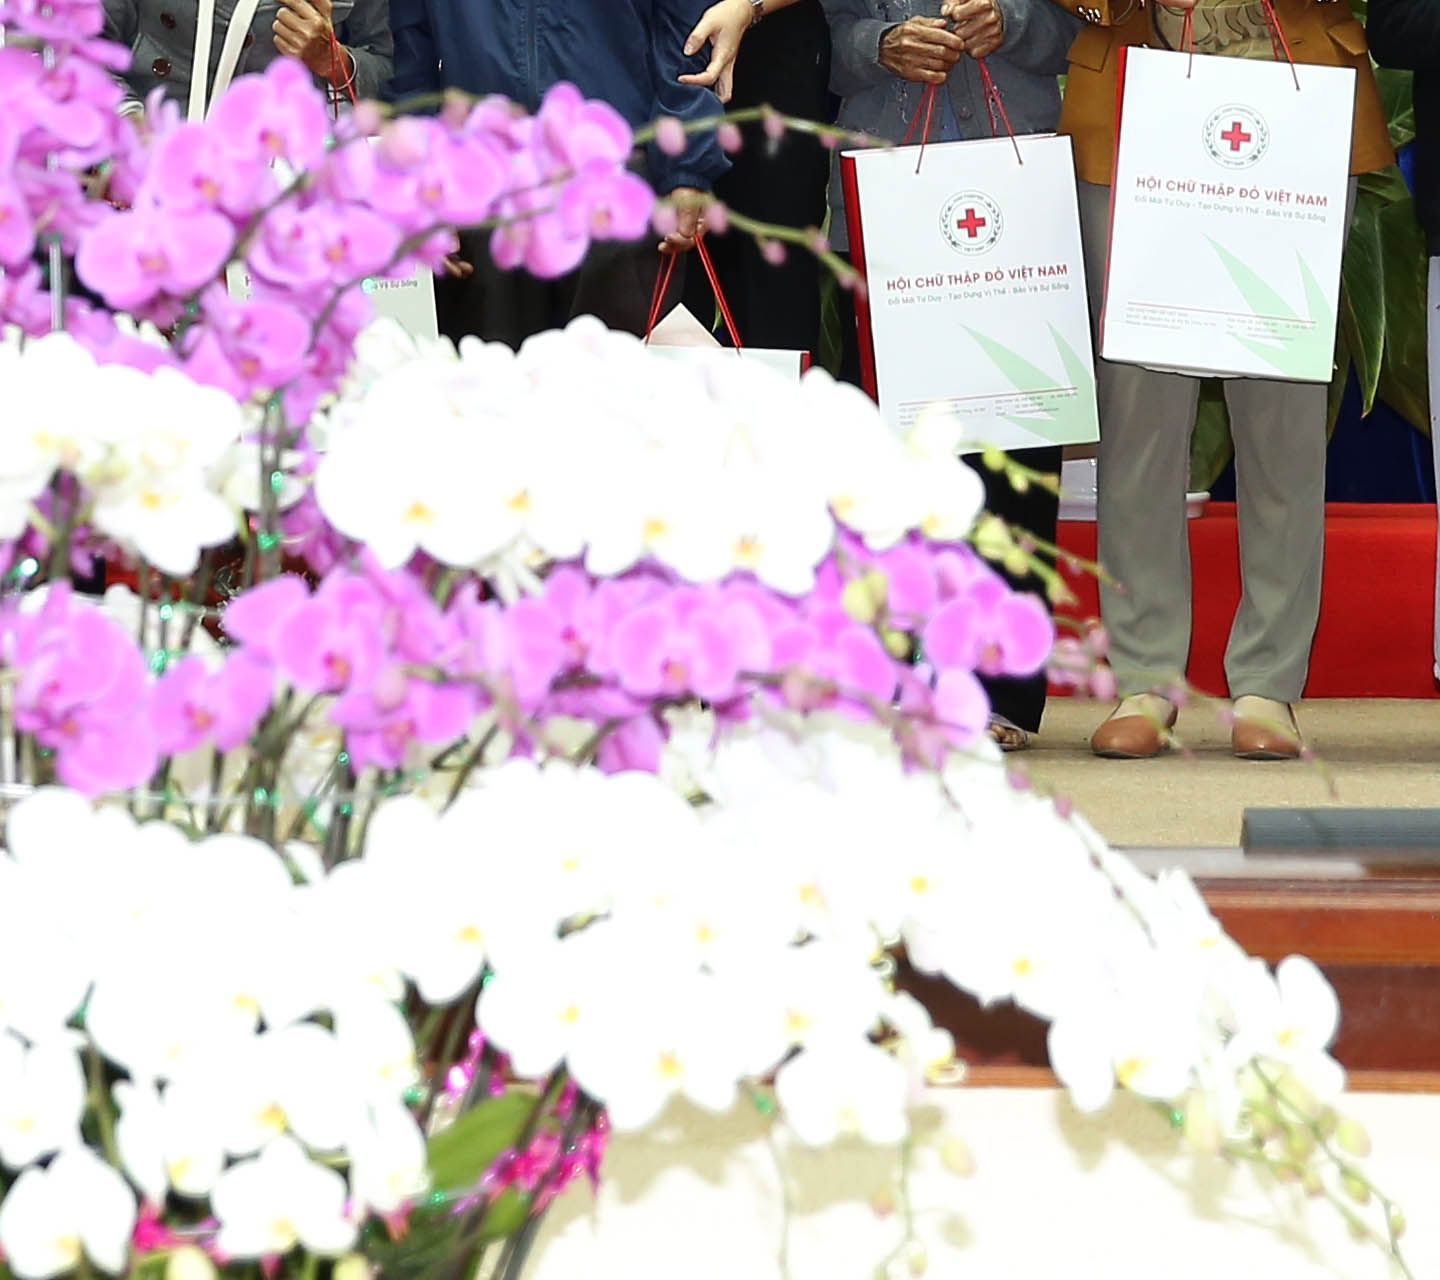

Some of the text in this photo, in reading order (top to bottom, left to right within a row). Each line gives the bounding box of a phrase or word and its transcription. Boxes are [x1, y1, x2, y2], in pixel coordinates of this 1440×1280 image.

[887, 264, 1068, 293] HỘI CHỮ THẬP ĐỎ VIỆT NAM
